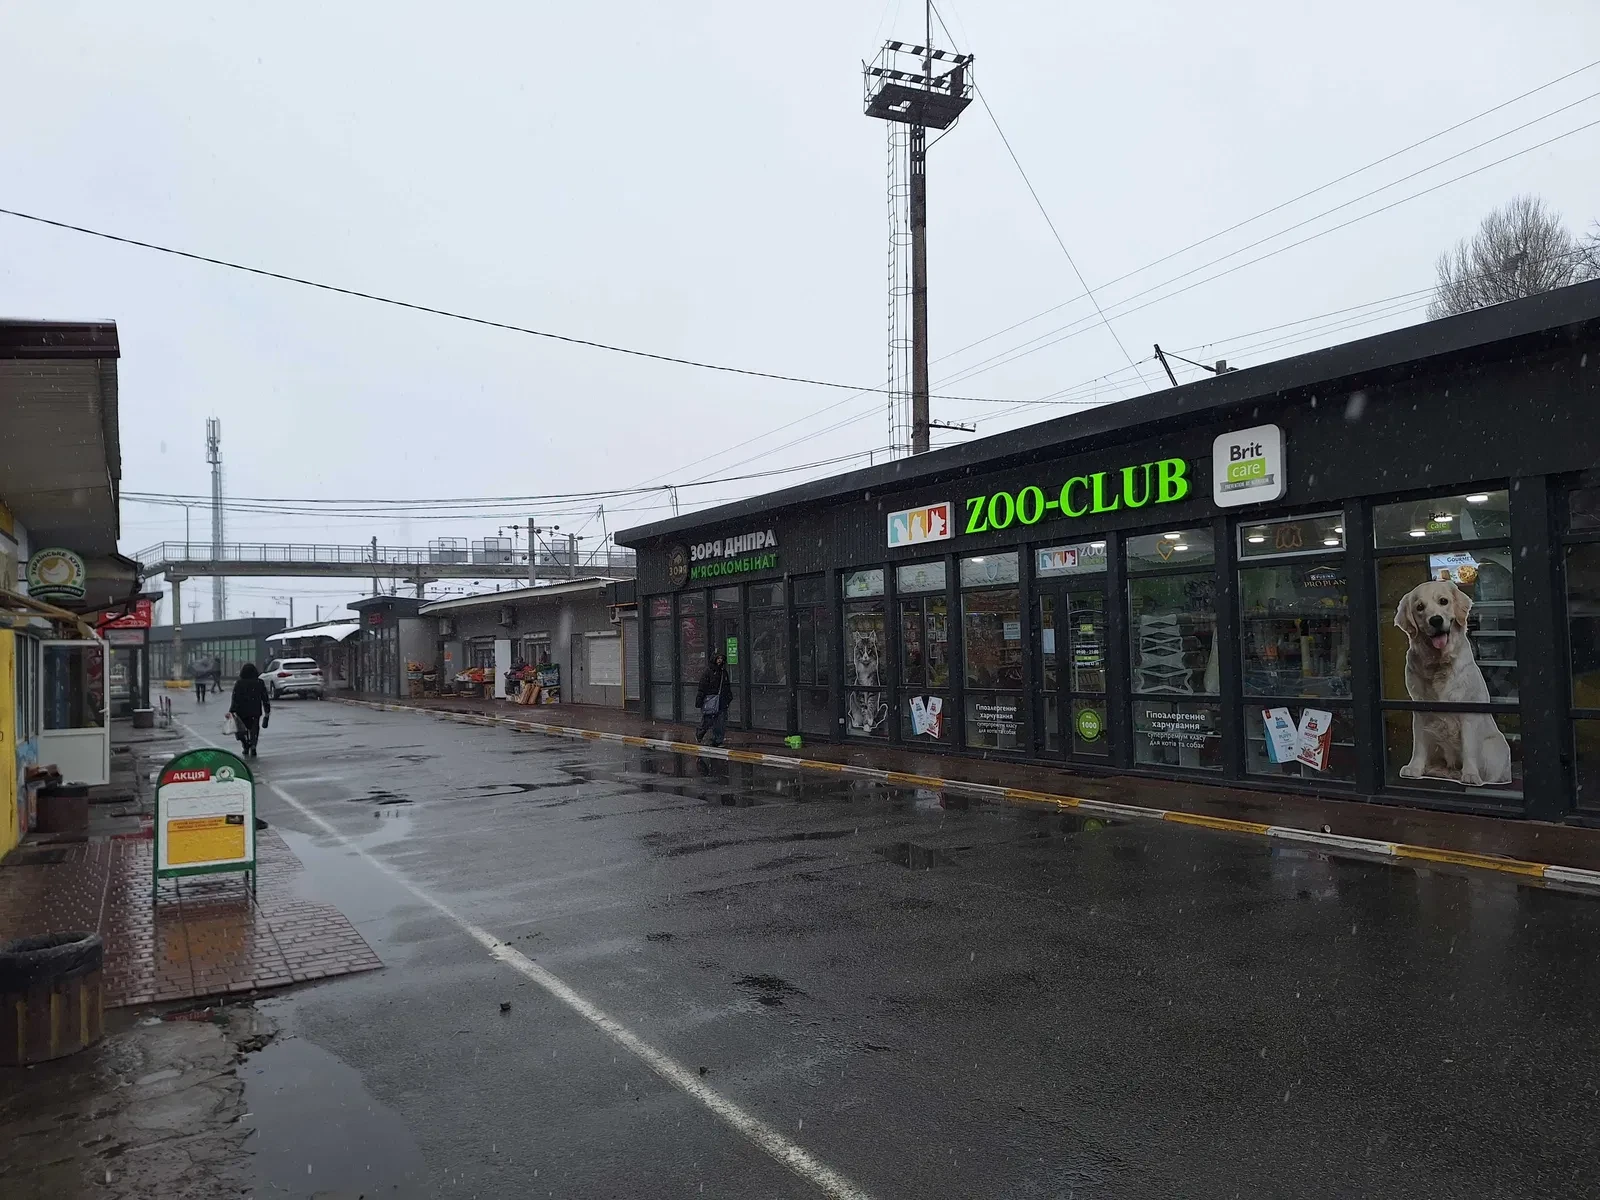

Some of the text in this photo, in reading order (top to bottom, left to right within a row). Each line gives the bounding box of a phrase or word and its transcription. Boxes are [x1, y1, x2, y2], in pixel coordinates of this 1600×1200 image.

[1230, 442, 1262, 461] Brit
[1232, 463, 1261, 477] care
[965, 457, 1189, 534] ZOO-CLUB
[690, 529, 776, 561] ЗОРЯ ДНІПРА
[669, 565, 688, 576] ЗОРЯ
[1146, 710, 1206, 721] Гіпоалергенне
[1082, 721, 1097, 729] 1000
[1152, 721, 1200, 730] харчування
[172, 771, 205, 781] АКЦІЯ
